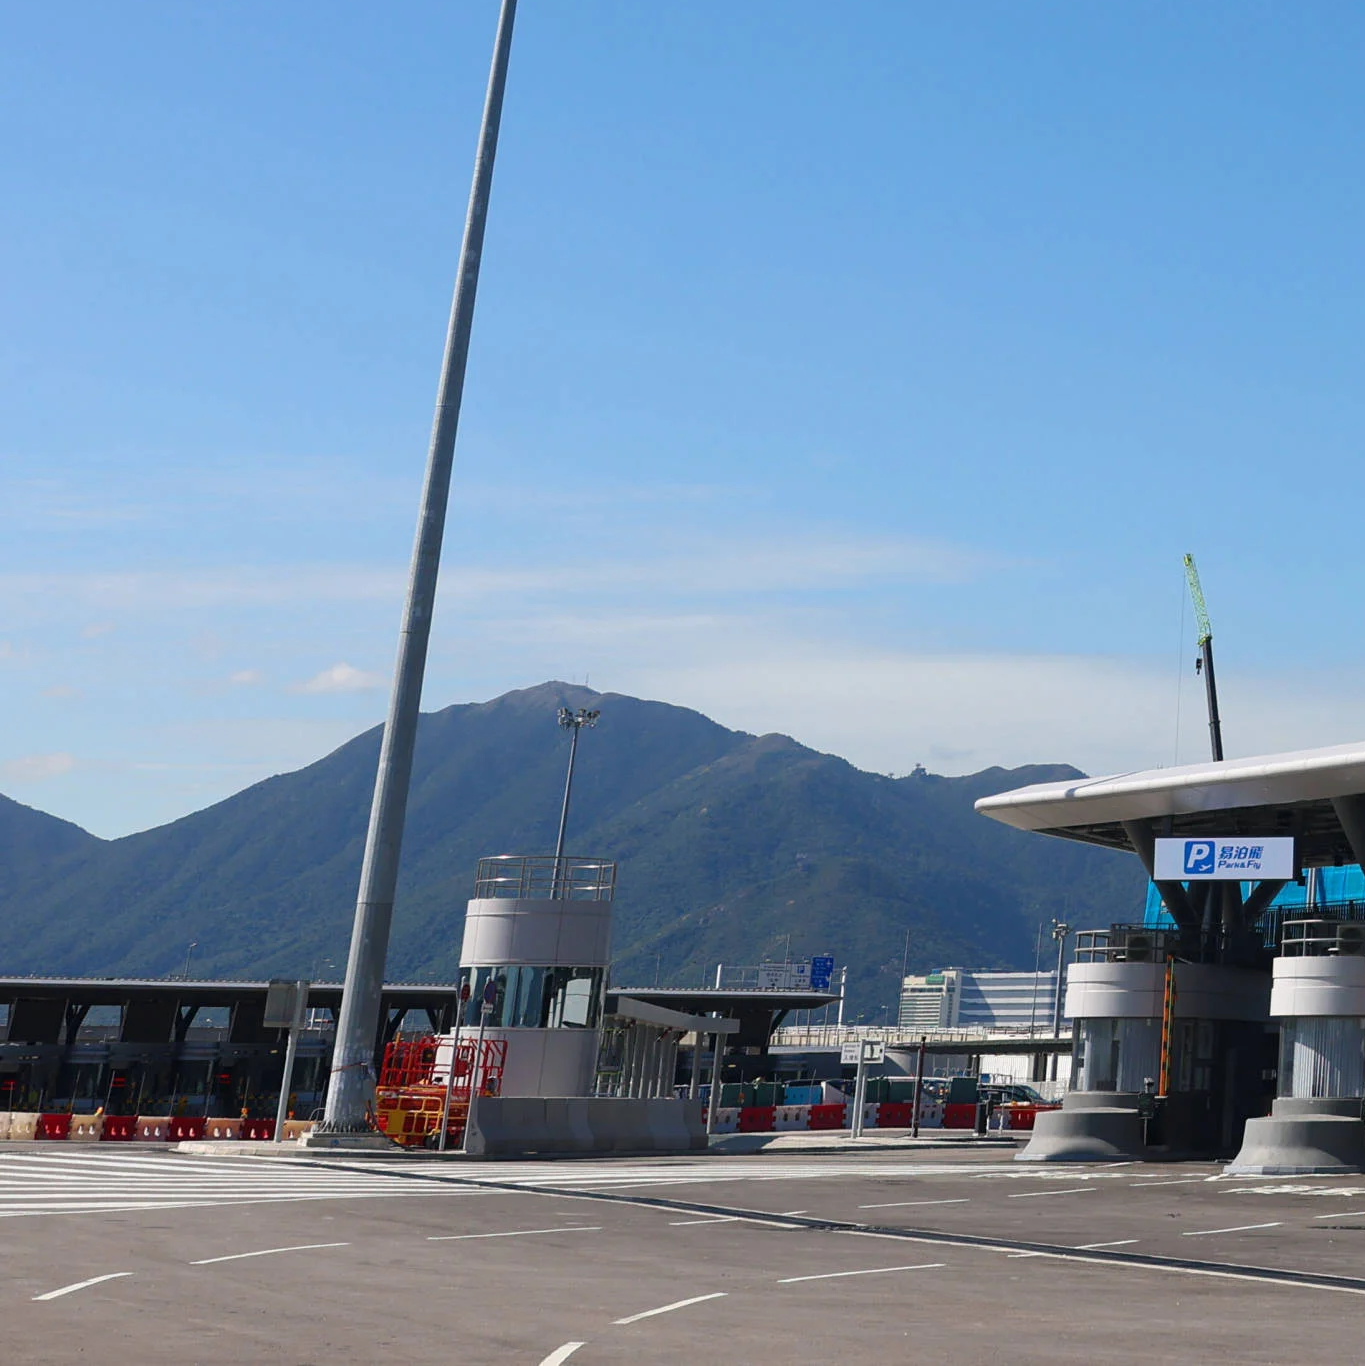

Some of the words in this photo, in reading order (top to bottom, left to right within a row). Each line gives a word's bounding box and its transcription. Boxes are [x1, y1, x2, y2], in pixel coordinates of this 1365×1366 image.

[1186, 844, 1210, 869] P
[1218, 846, 1264, 859] 易泊飛
[1218, 860, 1262, 869] Park&Fly
